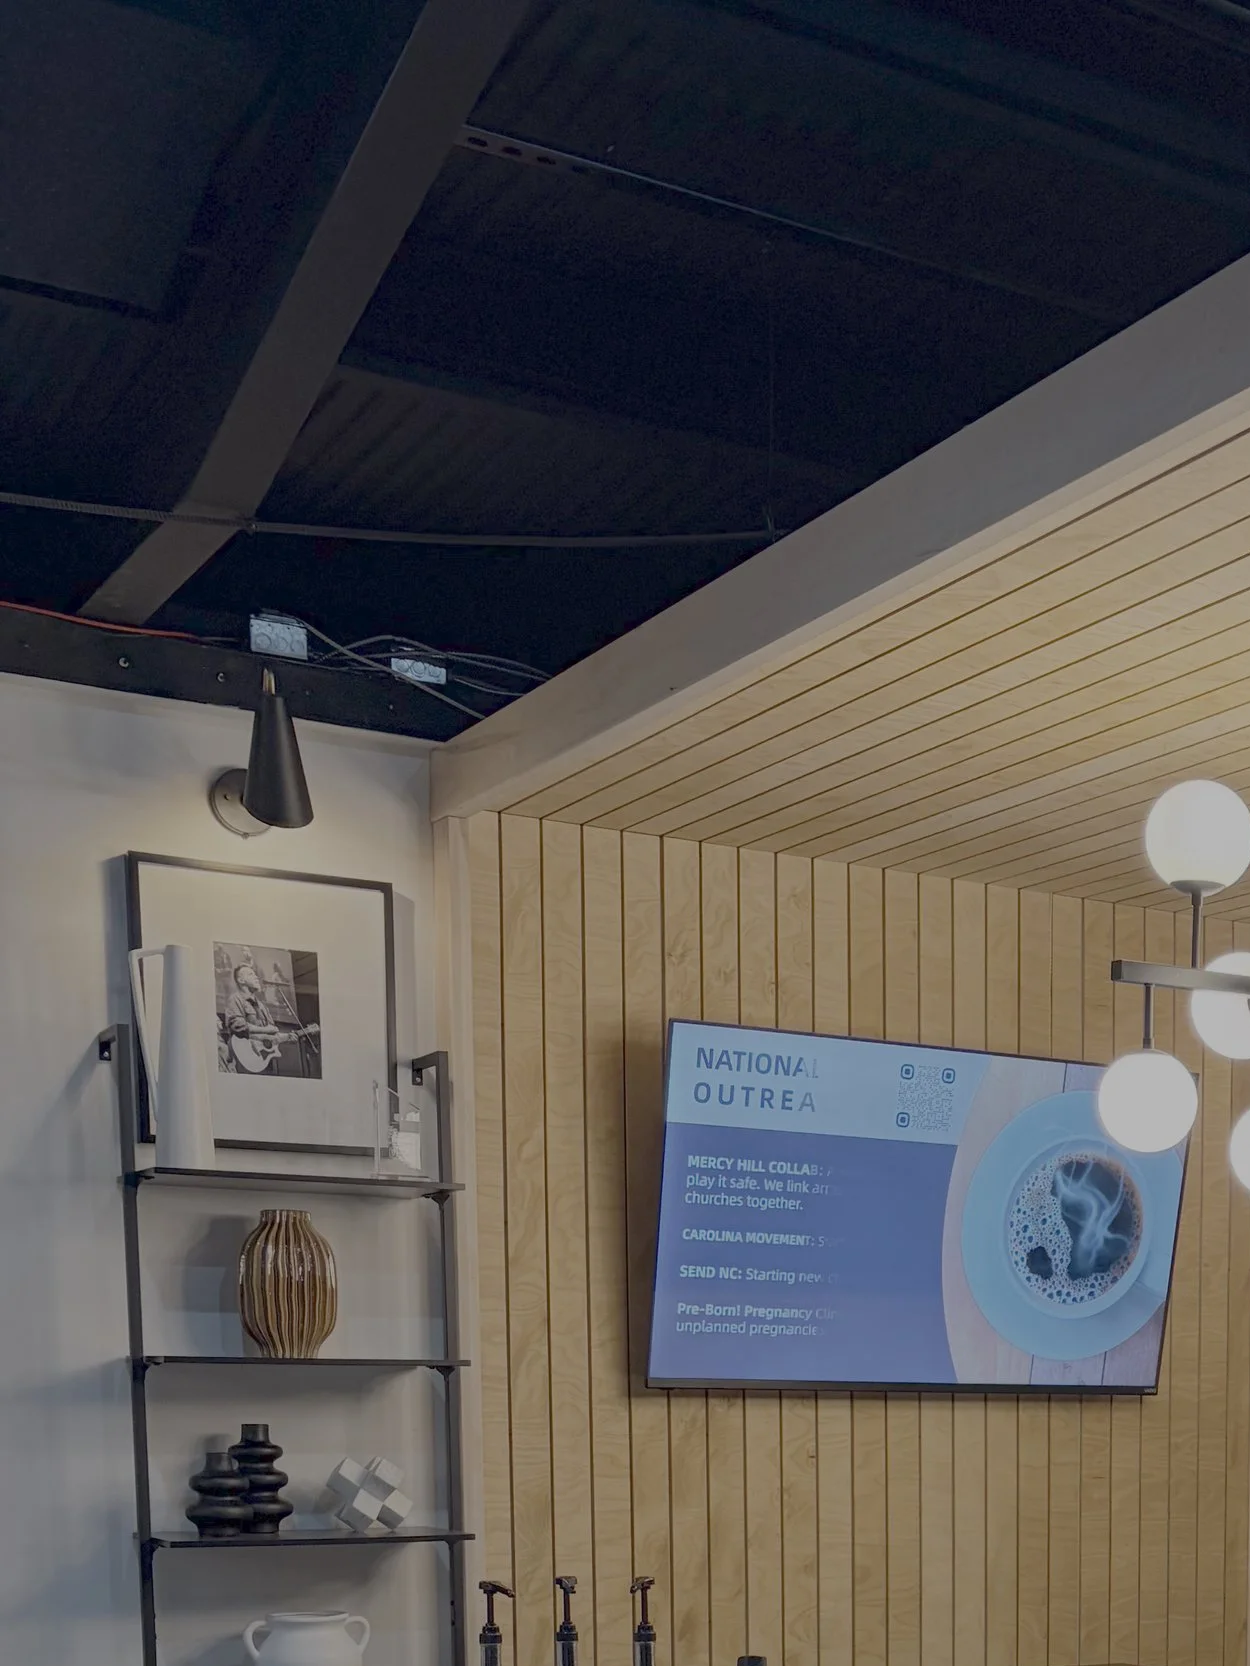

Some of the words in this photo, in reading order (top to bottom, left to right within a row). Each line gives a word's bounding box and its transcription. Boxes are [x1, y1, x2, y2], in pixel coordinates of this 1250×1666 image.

[695, 1046, 820, 1079] NATIONAL
[687, 1155, 735, 1170] MERCY
[737, 1159, 766, 1173] HILL
[768, 1161, 824, 1177] COLLAB:
[686, 1173, 715, 1190] play
[718, 1174, 727, 1188] it
[729, 1176, 761, 1190] safe.
[764, 1179, 783, 1192] We
[786, 1180, 810, 1194] link
[685, 1191, 743, 1207] churches
[746, 1195, 804, 1211] together.
[682, 1228, 743, 1244] CAROLINA
[745, 1231, 816, 1247] MOVEMENT:
[679, 1264, 716, 1279] SEND
[719, 1266, 742, 1280] NC:
[745, 1268, 796, 1285] Starting
[677, 1301, 741, 1317] Pre-Born!
[744, 1304, 813, 1321] Pregnancy
[676, 1319, 747, 1335] unplanned
[749, 1323, 822, 1338] pregnancie
